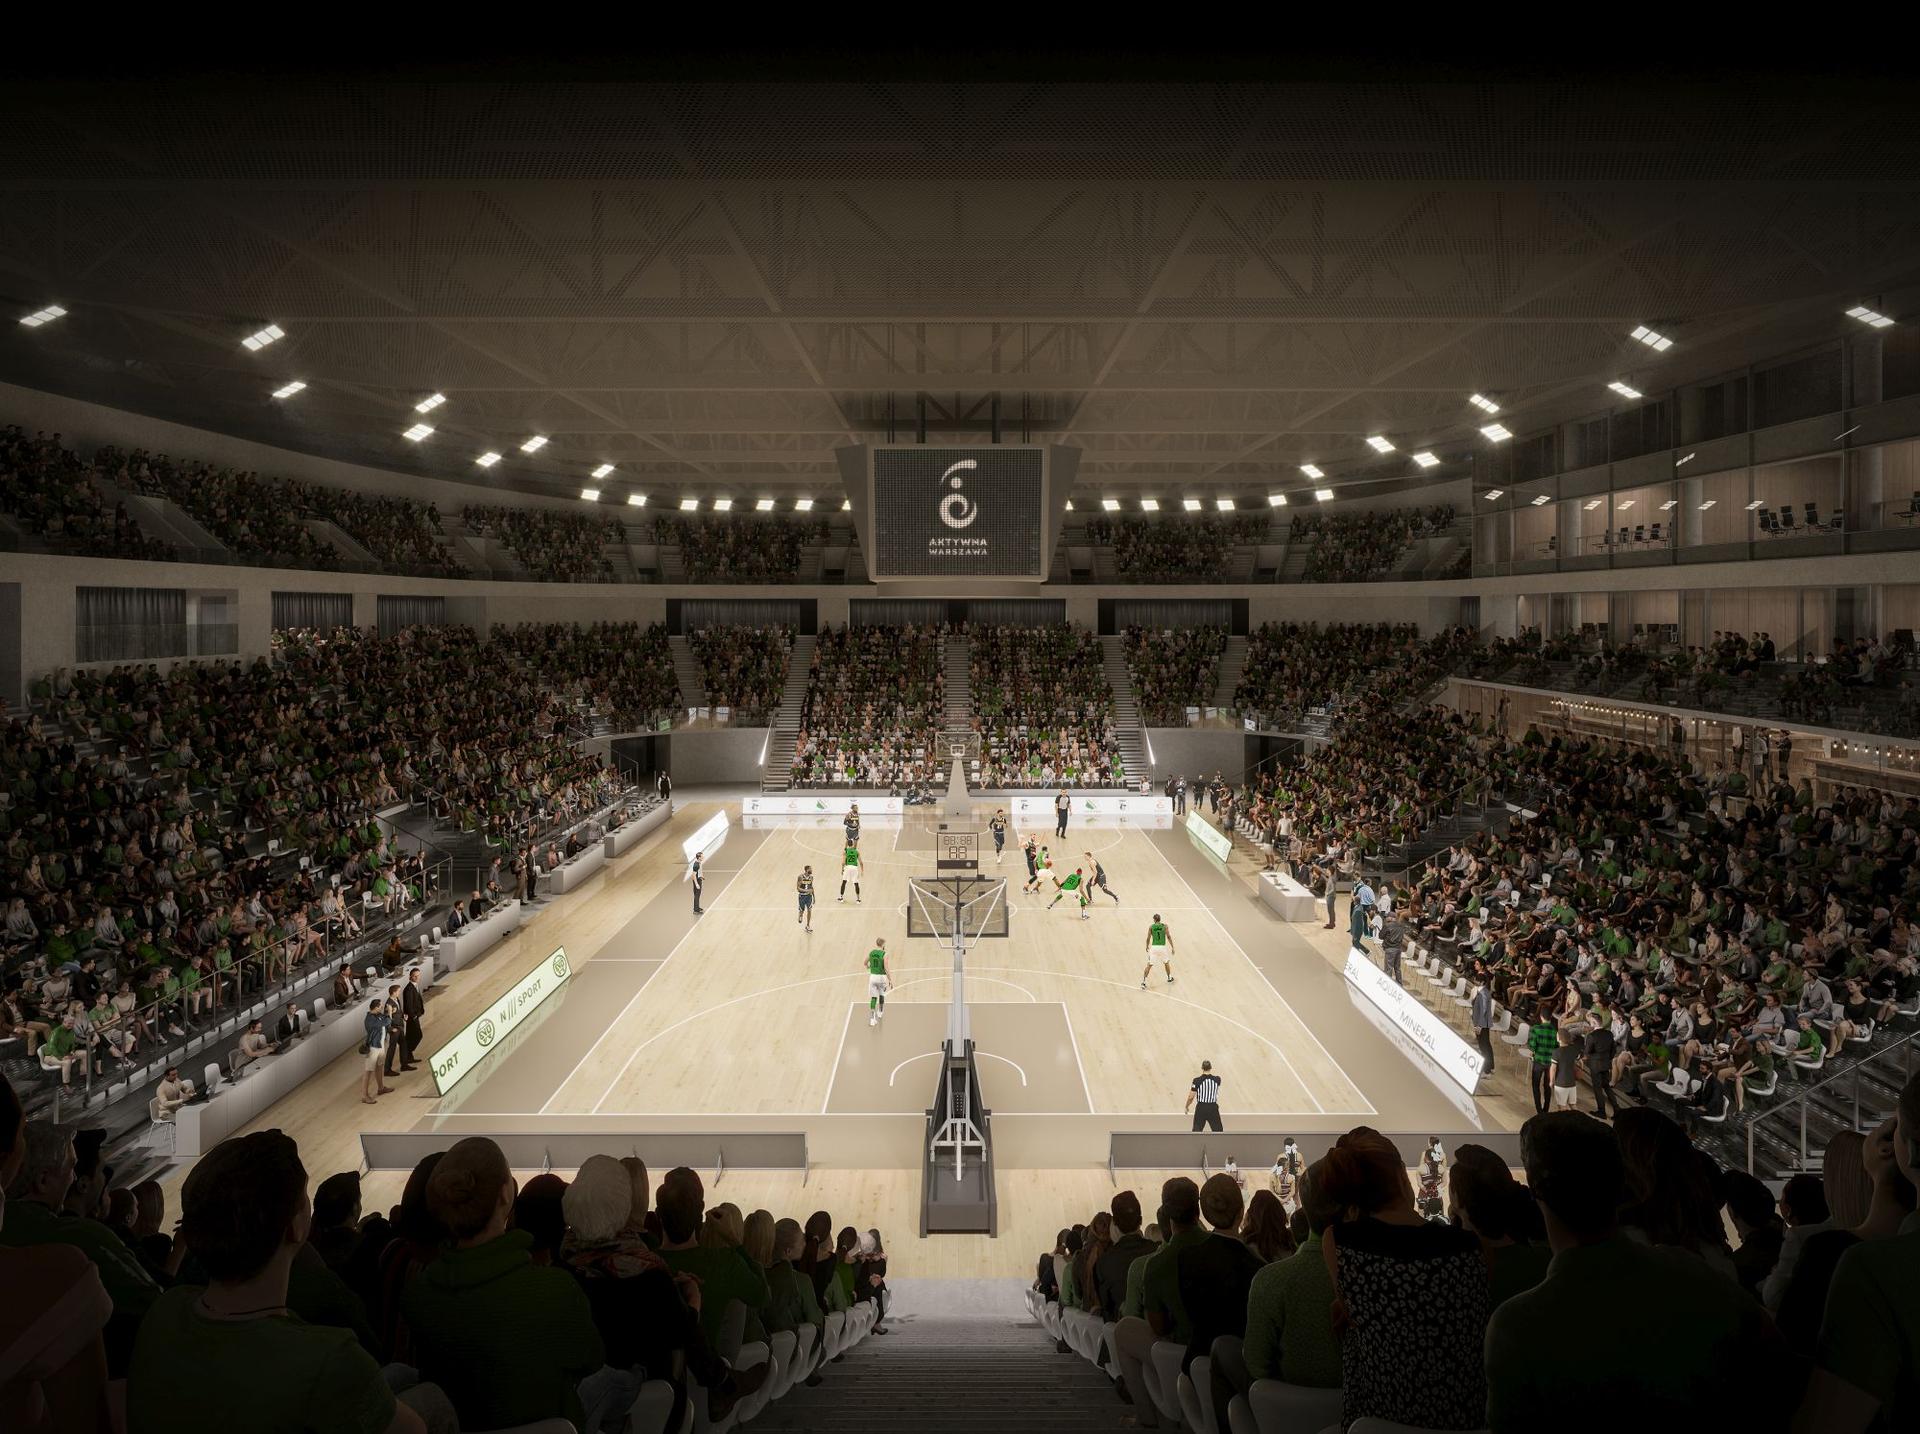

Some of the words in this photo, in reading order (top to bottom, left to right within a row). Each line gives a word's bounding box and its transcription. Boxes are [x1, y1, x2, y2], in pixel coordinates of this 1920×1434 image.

[928, 538, 988, 546] AKTYWNA
[928, 548, 988, 556] WARSZAWA
[1376, 977, 1404, 1004] AQUAR
[1399, 1010, 1436, 1051] MINERAL
